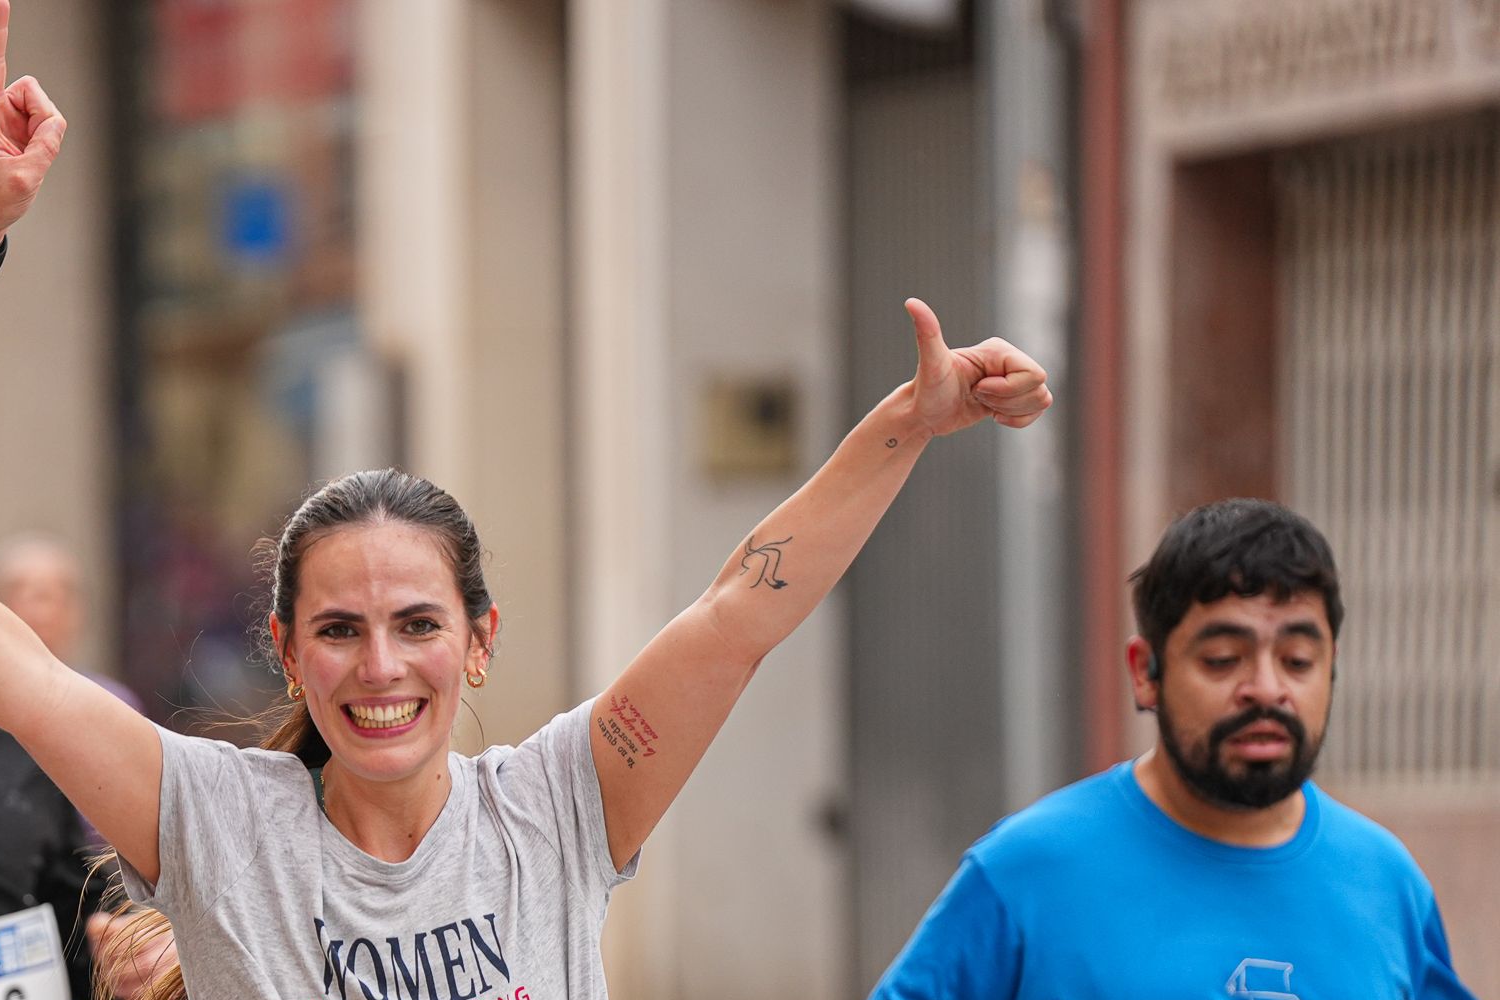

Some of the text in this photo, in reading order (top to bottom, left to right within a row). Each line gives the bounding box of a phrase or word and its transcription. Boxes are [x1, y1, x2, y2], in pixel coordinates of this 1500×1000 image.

[597, 716, 618, 746] quiero
[607, 718, 638, 754] recordar
[617, 746, 628, 757] no
